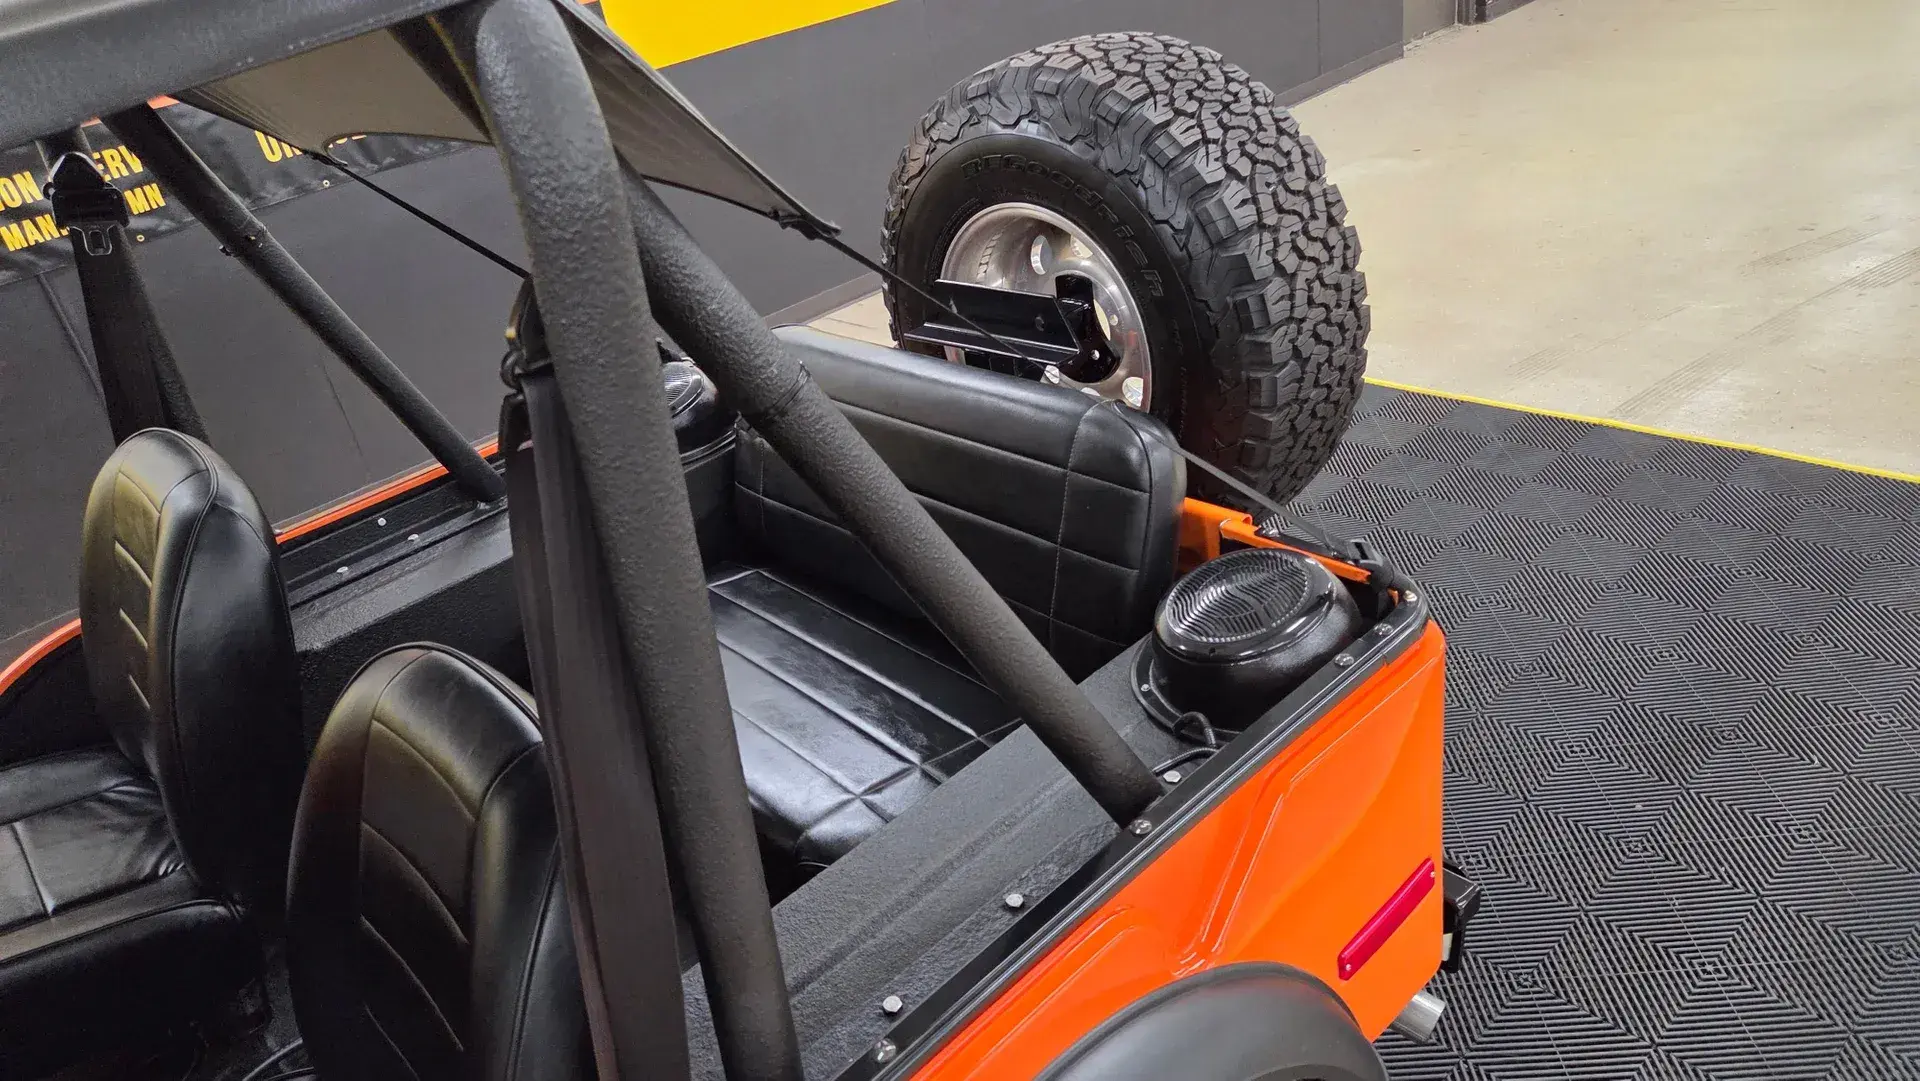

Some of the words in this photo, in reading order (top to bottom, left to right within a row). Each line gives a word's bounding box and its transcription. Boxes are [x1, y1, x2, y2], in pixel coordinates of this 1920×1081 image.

[0, 171, 44, 212] ON
[0, 213, 71, 252] MAN
[124, 183, 167, 215] MN
